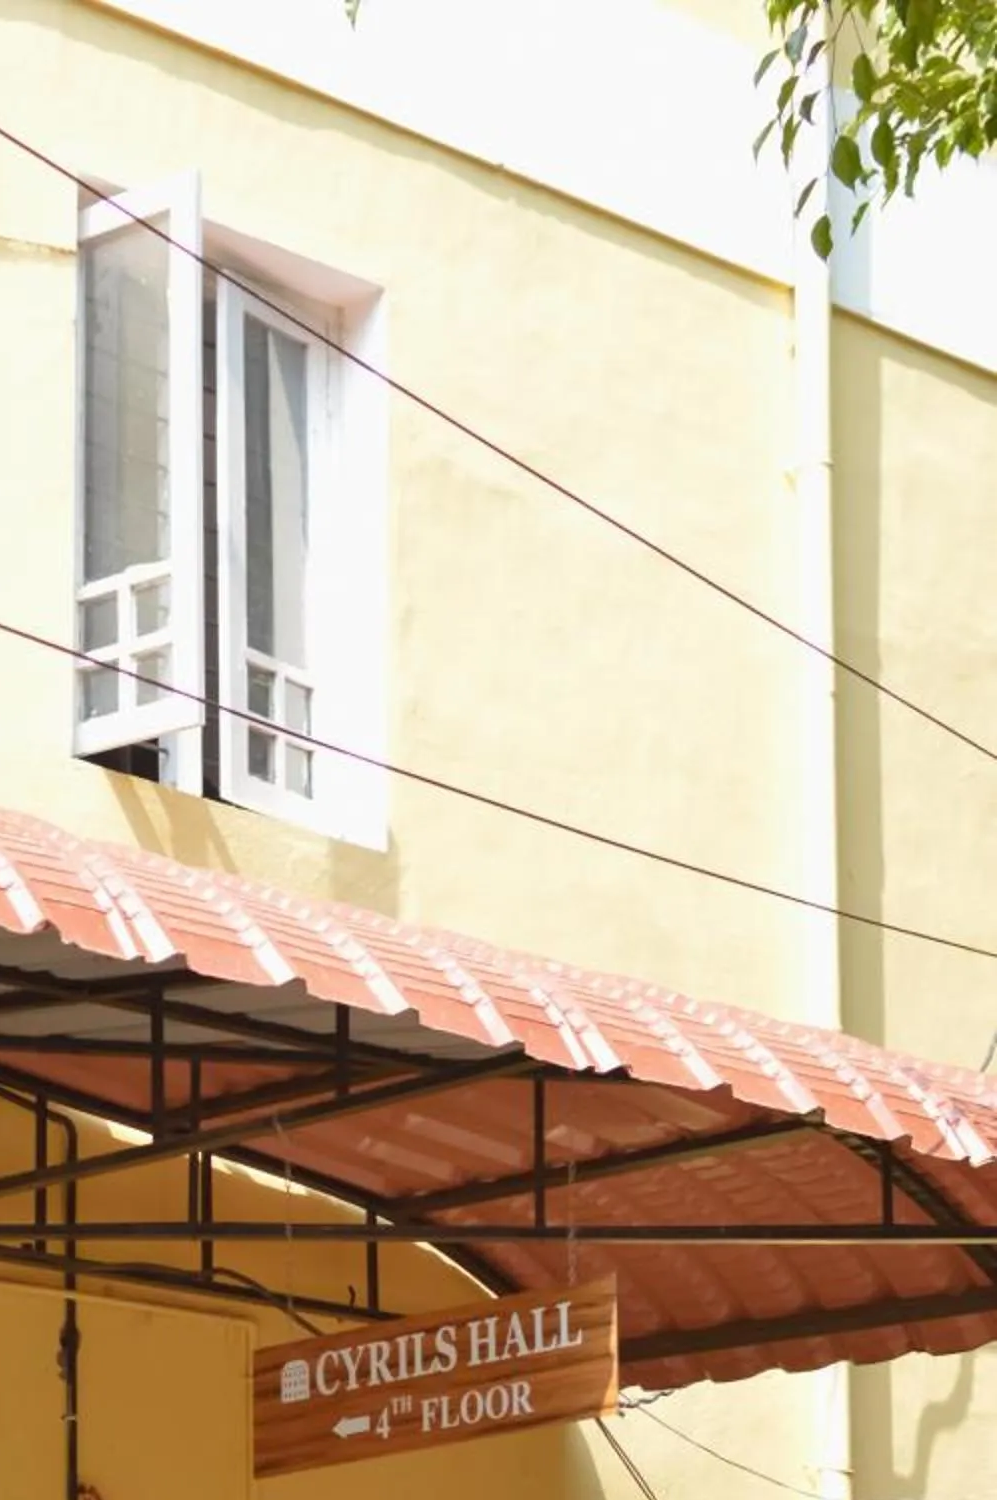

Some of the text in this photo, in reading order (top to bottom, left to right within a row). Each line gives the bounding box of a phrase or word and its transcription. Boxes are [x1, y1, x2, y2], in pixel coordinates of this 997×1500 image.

[316, 1301, 582, 1396] CYRILS HALL
[421, 1382, 534, 1432] FLOOR
